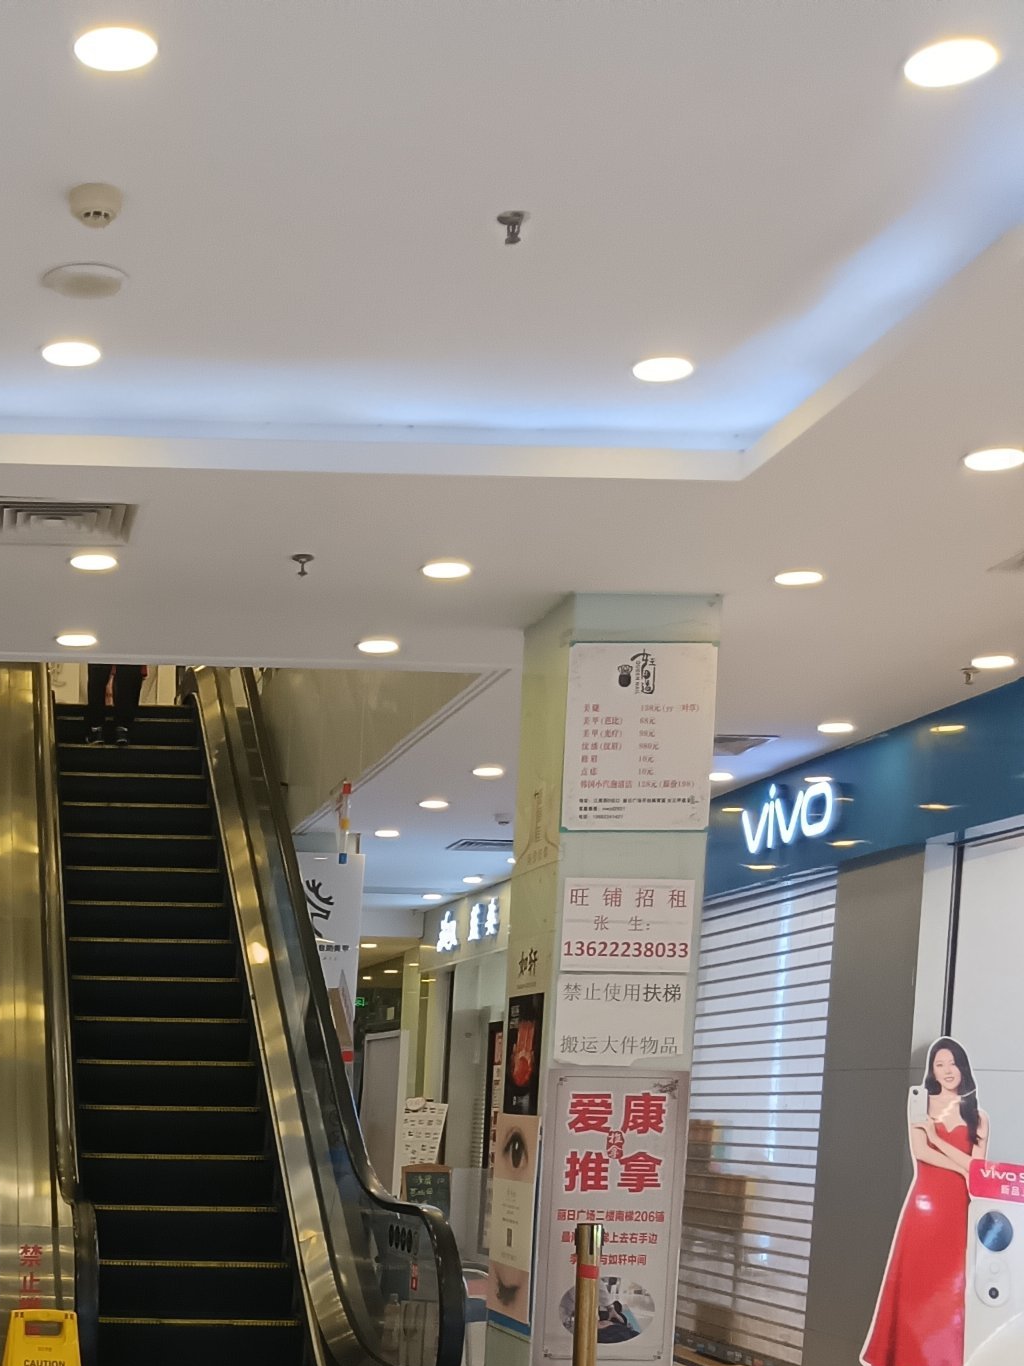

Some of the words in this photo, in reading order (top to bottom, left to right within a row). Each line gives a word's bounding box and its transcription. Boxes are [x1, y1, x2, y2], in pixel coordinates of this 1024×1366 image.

[741, 782, 833, 854] vivo
[569, 887, 688, 909] 旺铺招租
[563, 940, 689, 958] 13622238033
[563, 982, 682, 1003] 禁止使用扶梯
[559, 1034, 678, 1055] 搬运大件物品
[567, 1091, 667, 1135] 爱康
[563, 1150, 664, 1193] 推拿
[979, 1165, 1017, 1182] vivo
